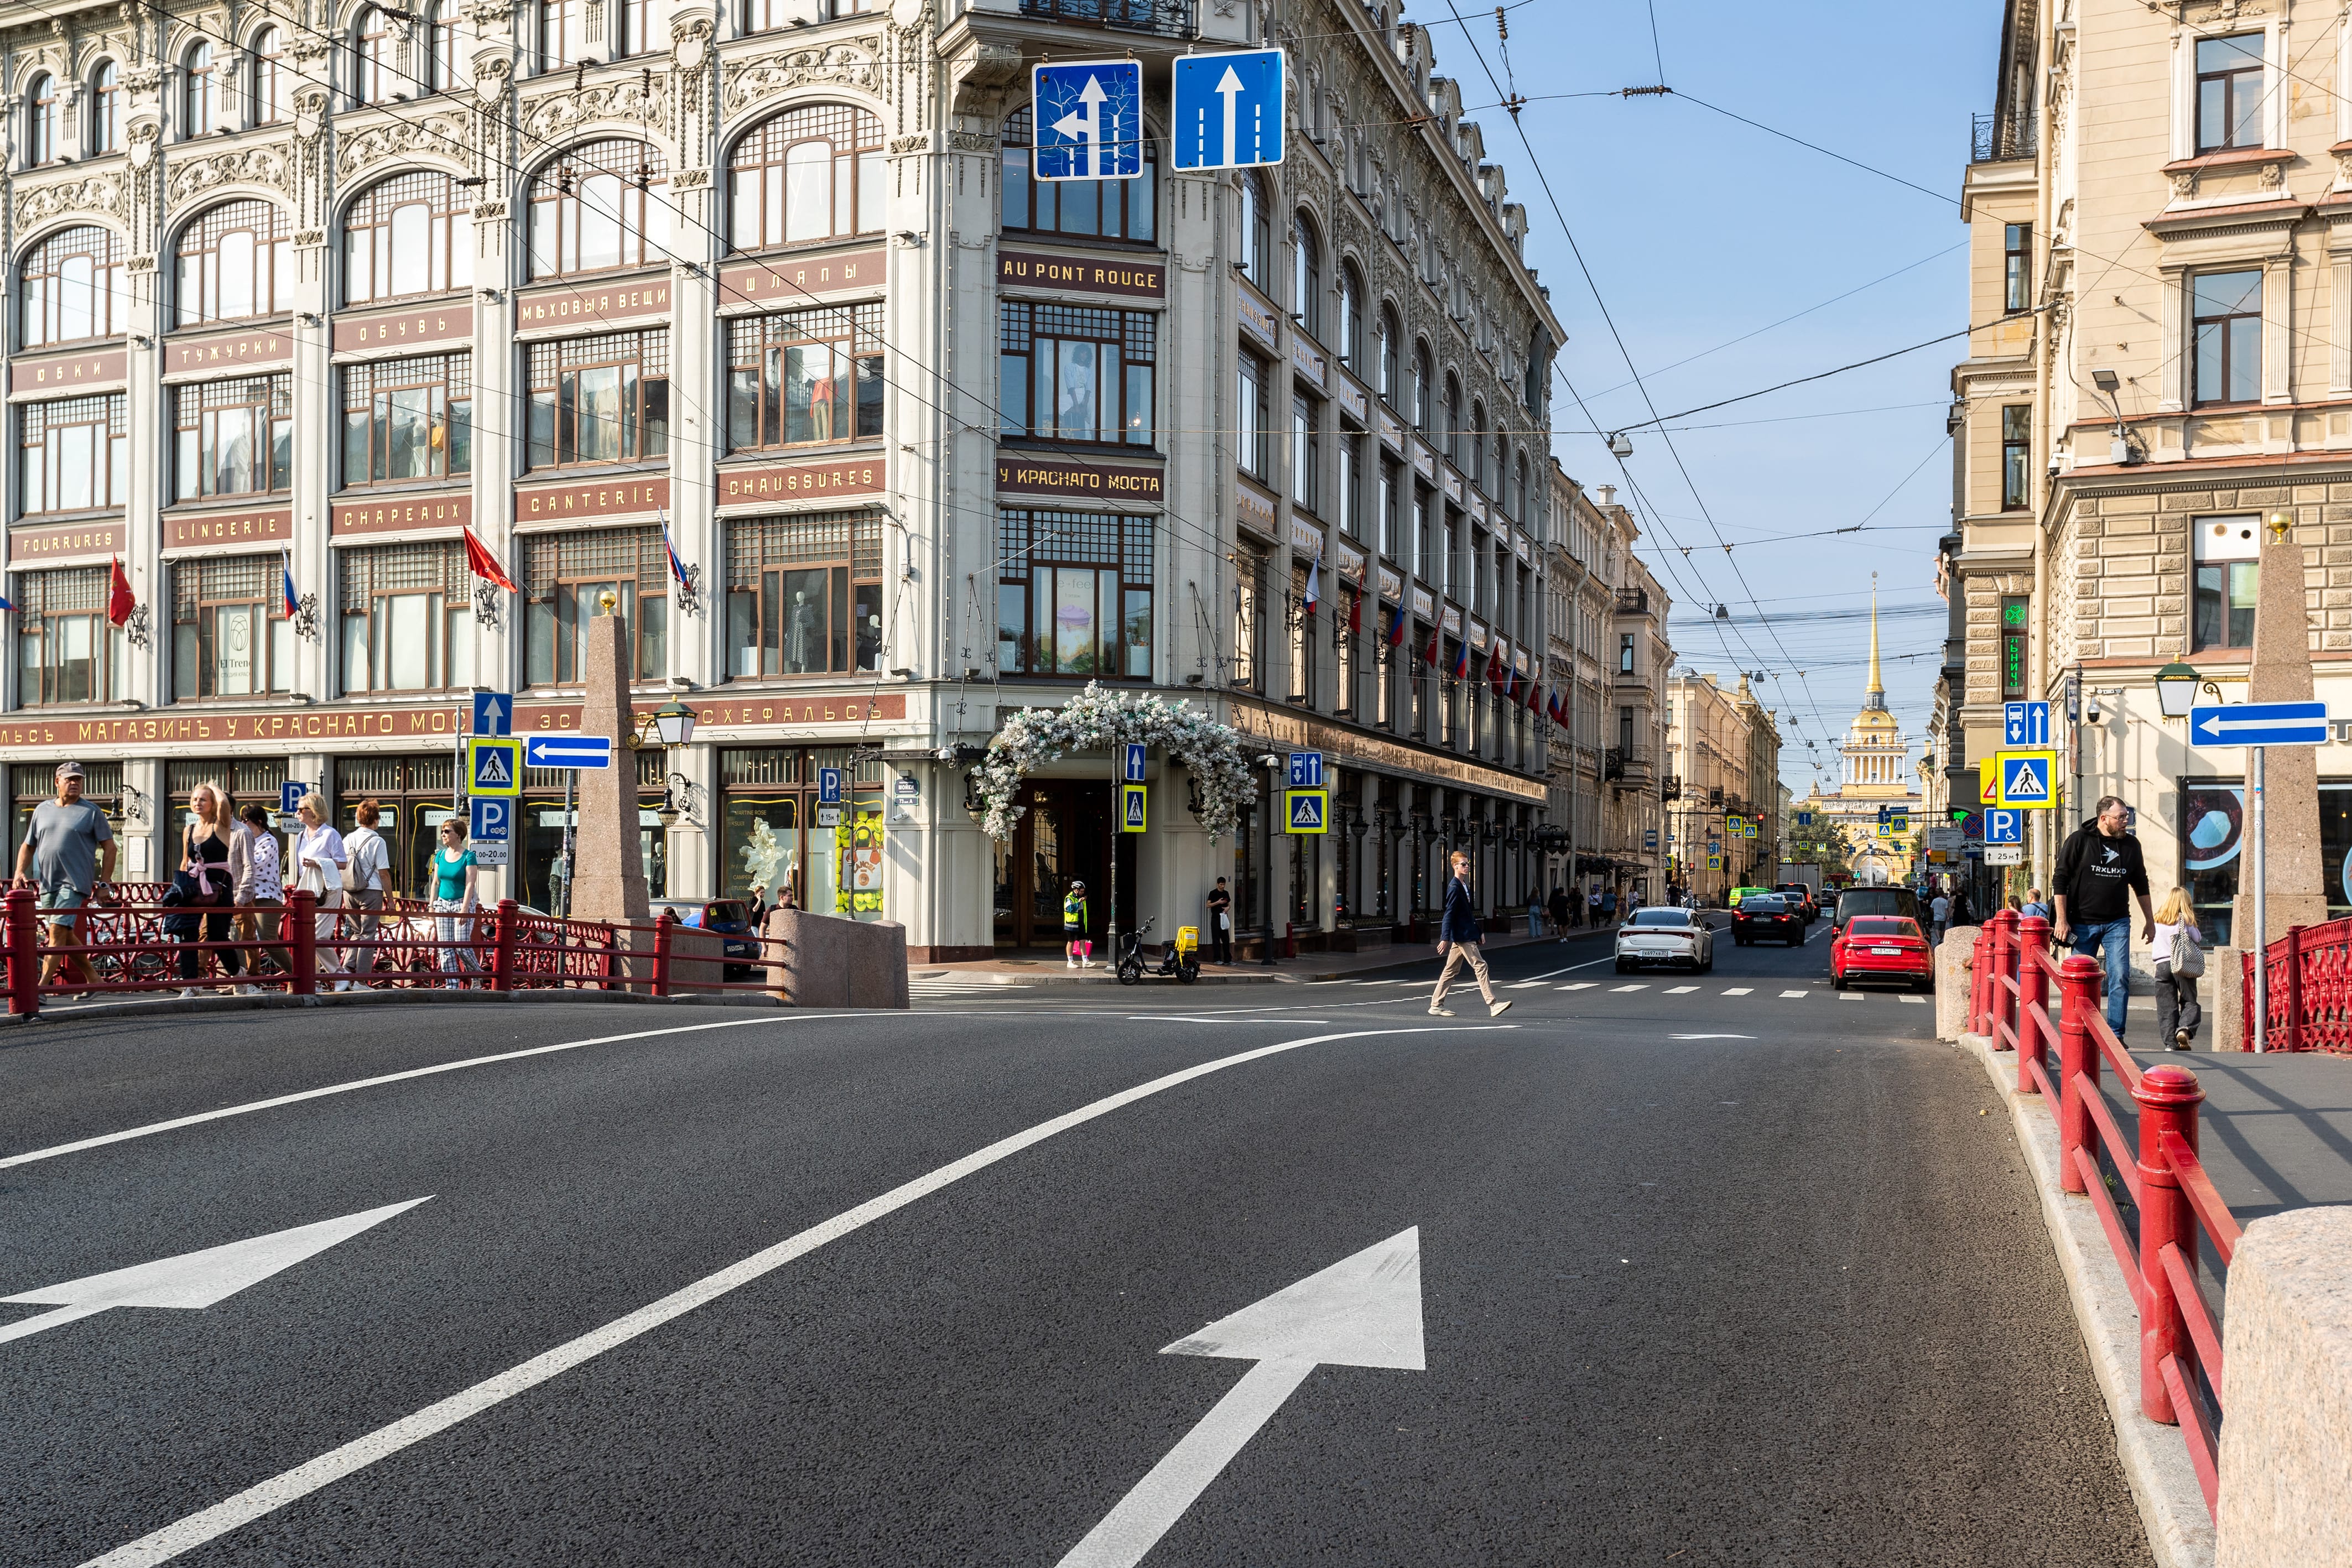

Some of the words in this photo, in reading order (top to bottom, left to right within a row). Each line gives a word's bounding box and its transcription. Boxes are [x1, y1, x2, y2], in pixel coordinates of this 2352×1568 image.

[746, 263, 856, 292] ШЛЯПЫ
[1003, 261, 1027, 276] AU
[1036, 263, 1085, 282] PONT
[1095, 269, 1157, 288] ROUGE
[618, 288, 667, 309] ВЕЩИ
[360, 317, 446, 341] ОБУВЬ
[182, 338, 277, 364] ТУЖУРКИ
[37, 362, 101, 383] ЮБКИ
[729, 468, 872, 496] CHAUSSURES
[1000, 468, 1009, 483] У
[1018, 469, 1100, 488] КРАСНАГО
[1108, 475, 1159, 492] МОСТА
[345, 504, 459, 527] CHAPEAUX
[24, 532, 113, 553] FOURRURES
[230, 659, 251, 668] Tren
[79, 720, 211, 741] МАГАЗИНЪ
[227, 719, 238, 737] У
[254, 714, 394, 737] КРАСНАГО
[411, 712, 466, 732] МОС
[703, 705, 882, 725] СХЕФАЛЬСЪ
[825, 772, 837, 799] P
[481, 803, 503, 835] P
[1993, 811, 2013, 838] P
